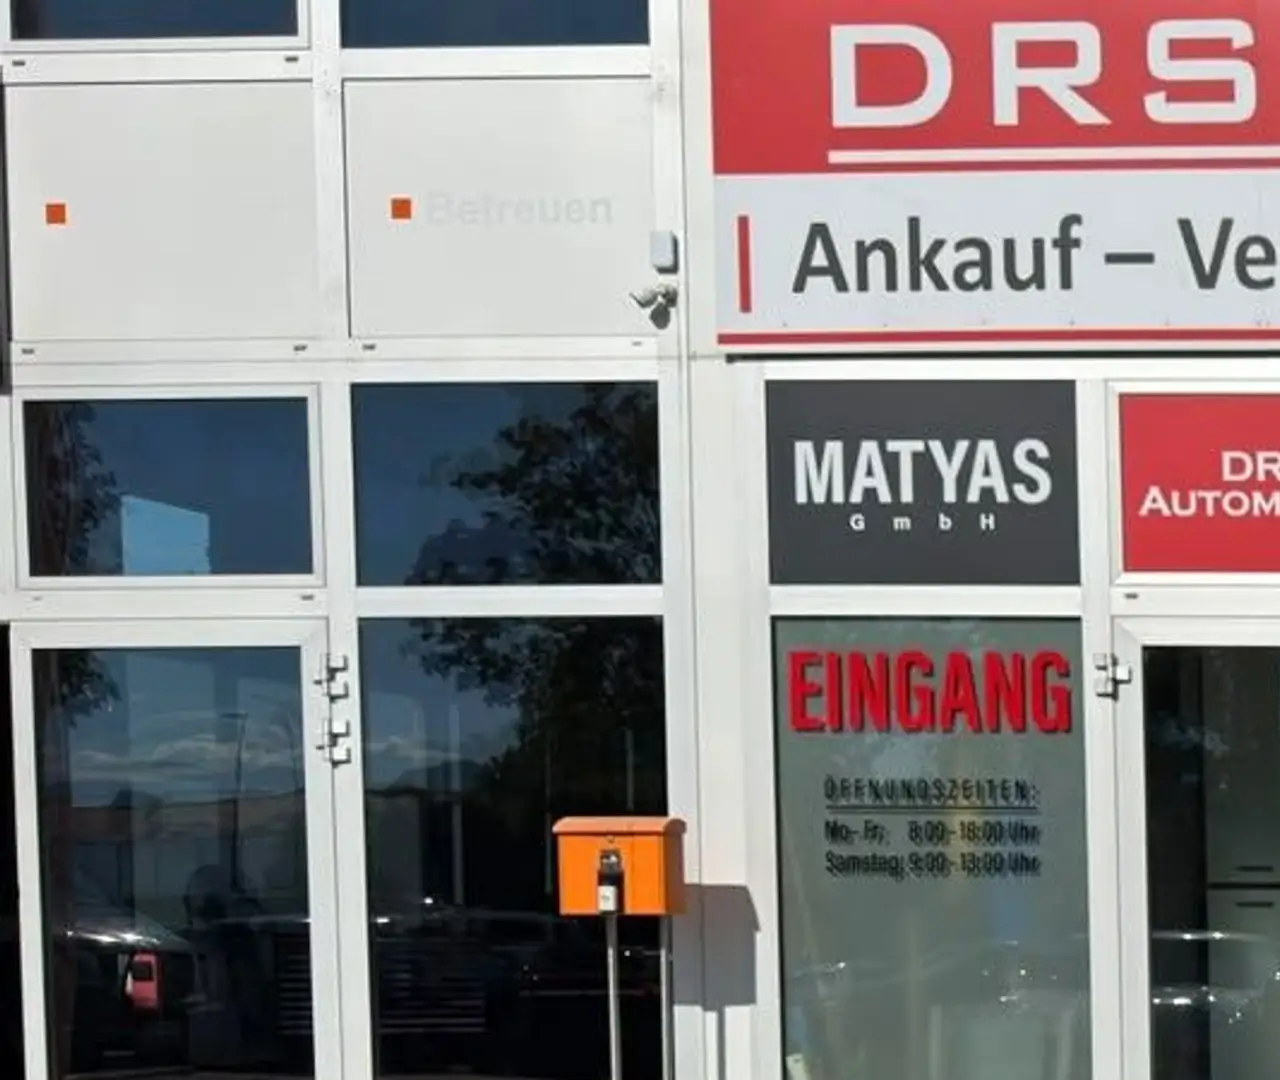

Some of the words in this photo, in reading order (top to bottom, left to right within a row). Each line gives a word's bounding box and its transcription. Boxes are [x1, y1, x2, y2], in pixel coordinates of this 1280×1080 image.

[830, 18, 1258, 128] DRS
[792, 214, 1083, 294] Ankauf
[794, 438, 1052, 505] MATYAS
[788, 650, 1073, 733] EINGANG
